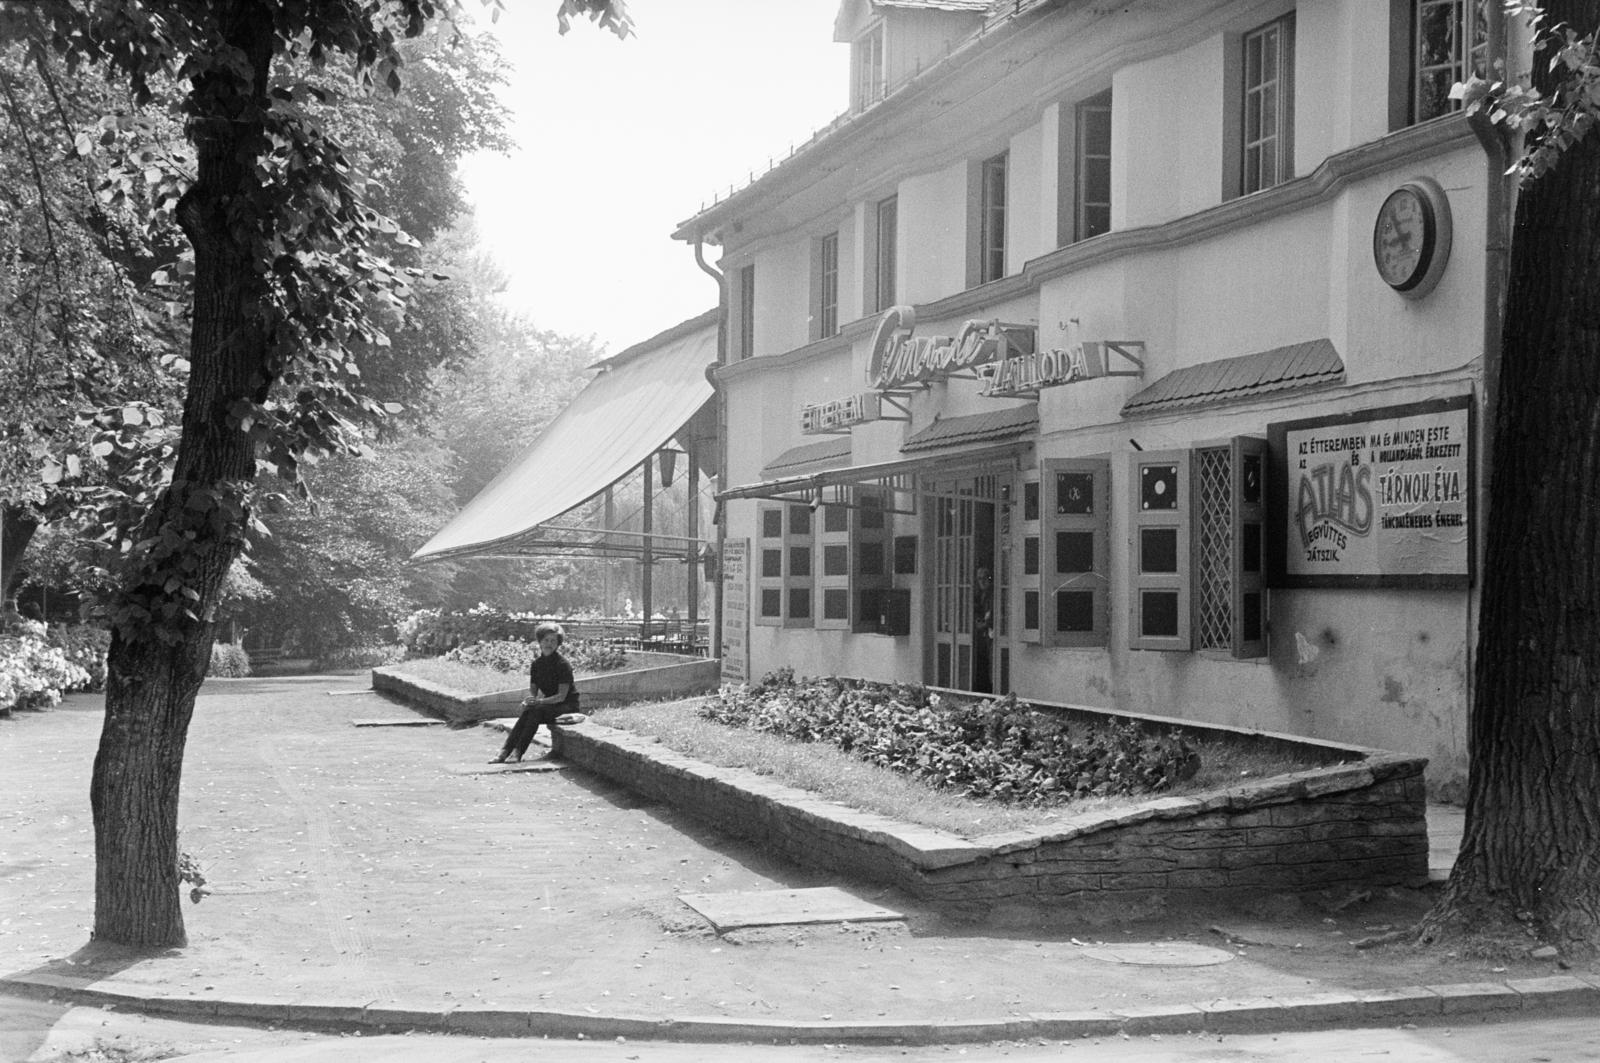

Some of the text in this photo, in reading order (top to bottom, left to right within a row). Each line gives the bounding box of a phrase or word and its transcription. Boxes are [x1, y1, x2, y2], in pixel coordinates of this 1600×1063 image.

[1298, 441, 1308, 455] AZ
[1310, 436, 1366, 454] ÉTTEREMBEN
[1369, 433, 1381, 448] MA
[1392, 428, 1425, 445] MINDEN
[1427, 426, 1450, 441] ESTE
[1425, 442, 1461, 459] ÉRKEZETT
[1298, 459, 1307, 469] AZ
[1351, 450, 1360, 466] ÉS
[1380, 464, 1461, 505] TÁRNOK ÉVA
[1296, 460, 1374, 549] ATLAS
[1307, 520, 1348, 550] EGYÜTTES
[1307, 546, 1340, 562] JÁTSZIK
